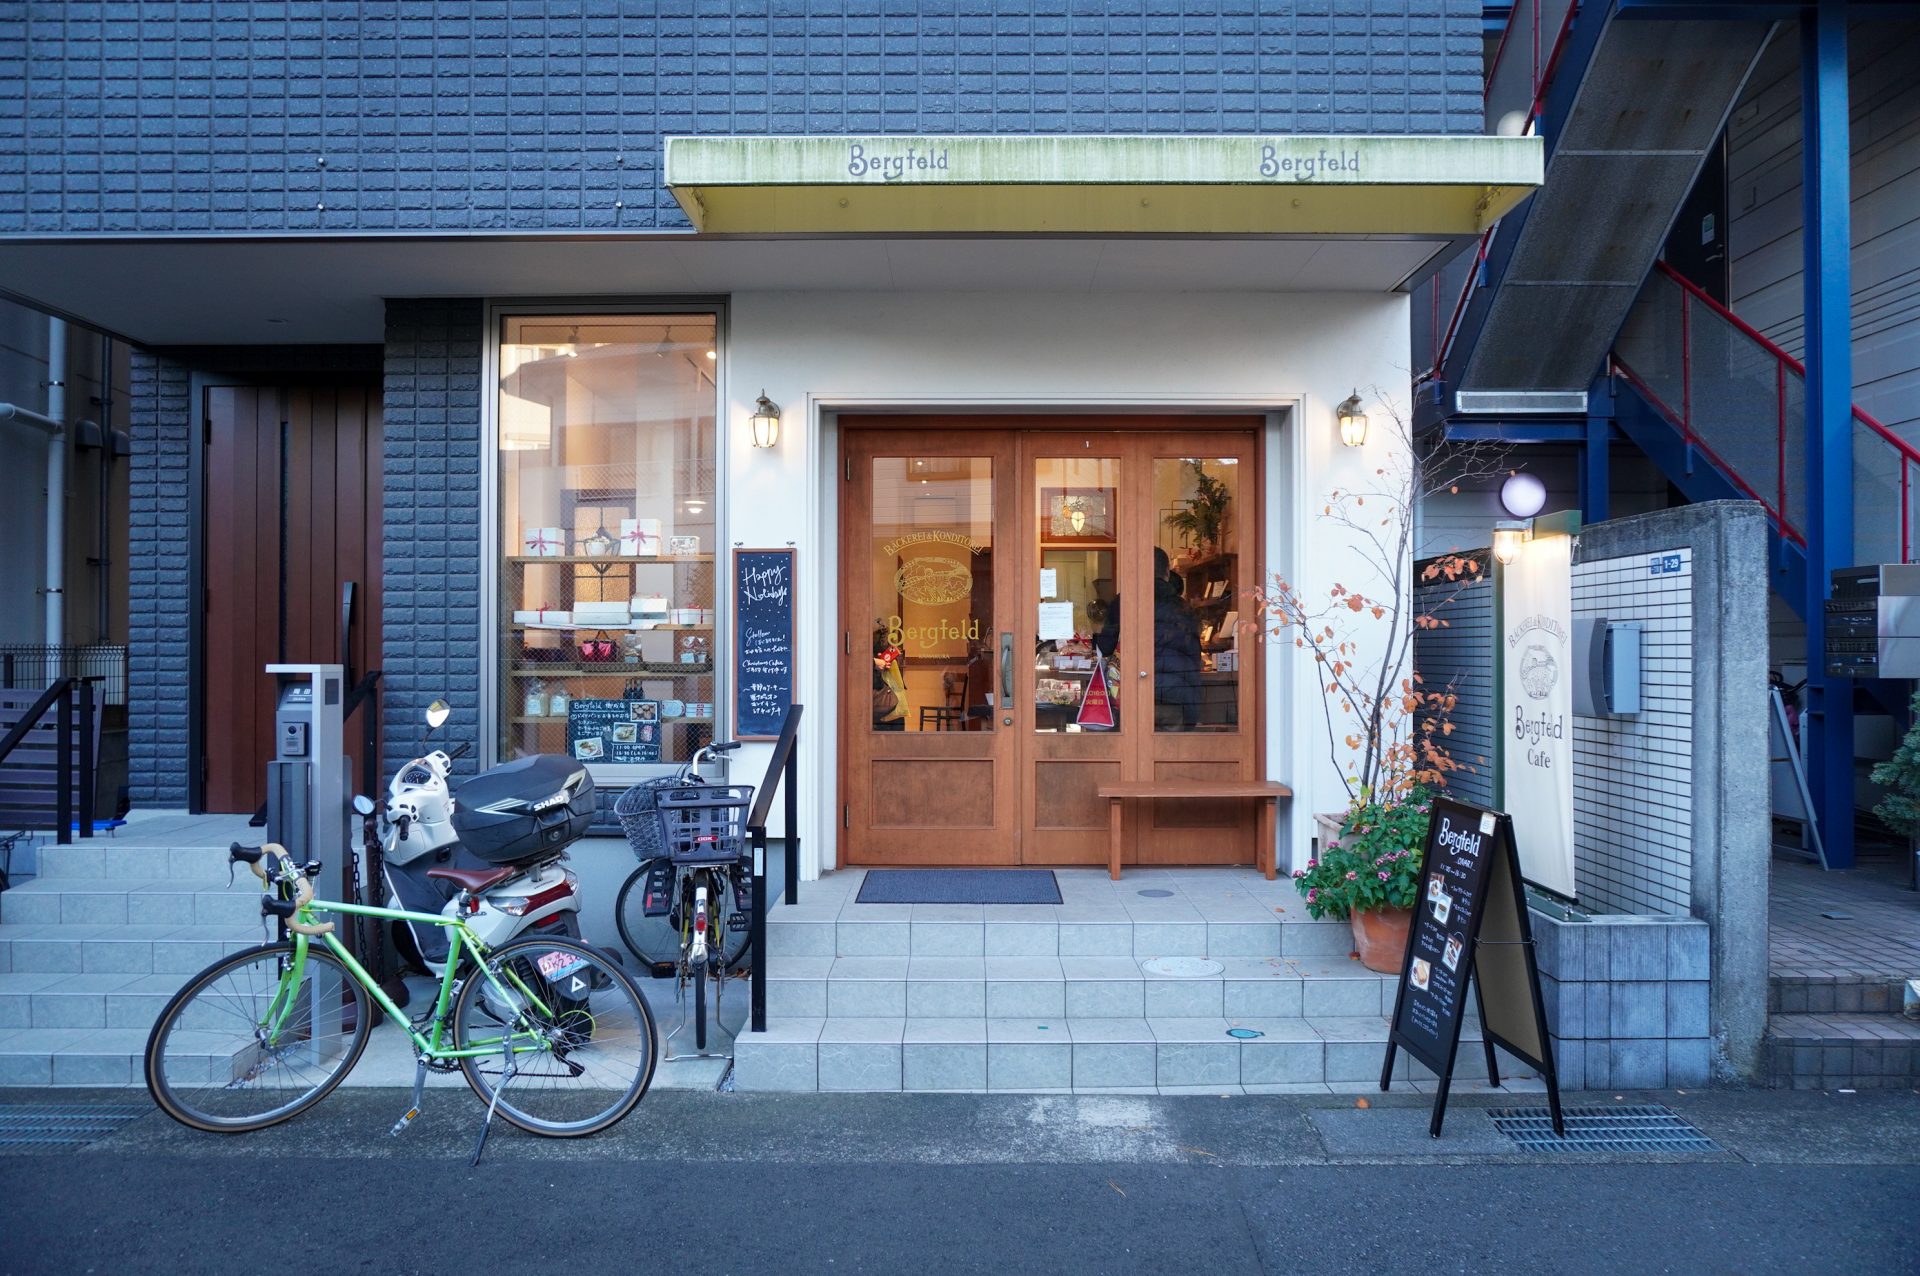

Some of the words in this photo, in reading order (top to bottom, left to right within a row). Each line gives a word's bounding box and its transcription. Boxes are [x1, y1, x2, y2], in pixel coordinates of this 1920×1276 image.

[848, 144, 949, 180] Bergfeld
[1260, 145, 1360, 181] Bergfeld
[743, 566, 786, 586] Happy
[744, 586, 787, 606] Holidays
[888, 615, 980, 649] Bergfeld
[1515, 705, 1563, 745] Bergfeld
[1527, 748, 1551, 769] Cafe
[533, 795, 564, 811] SHAD
[1438, 817, 1482, 857] Bergfeld
